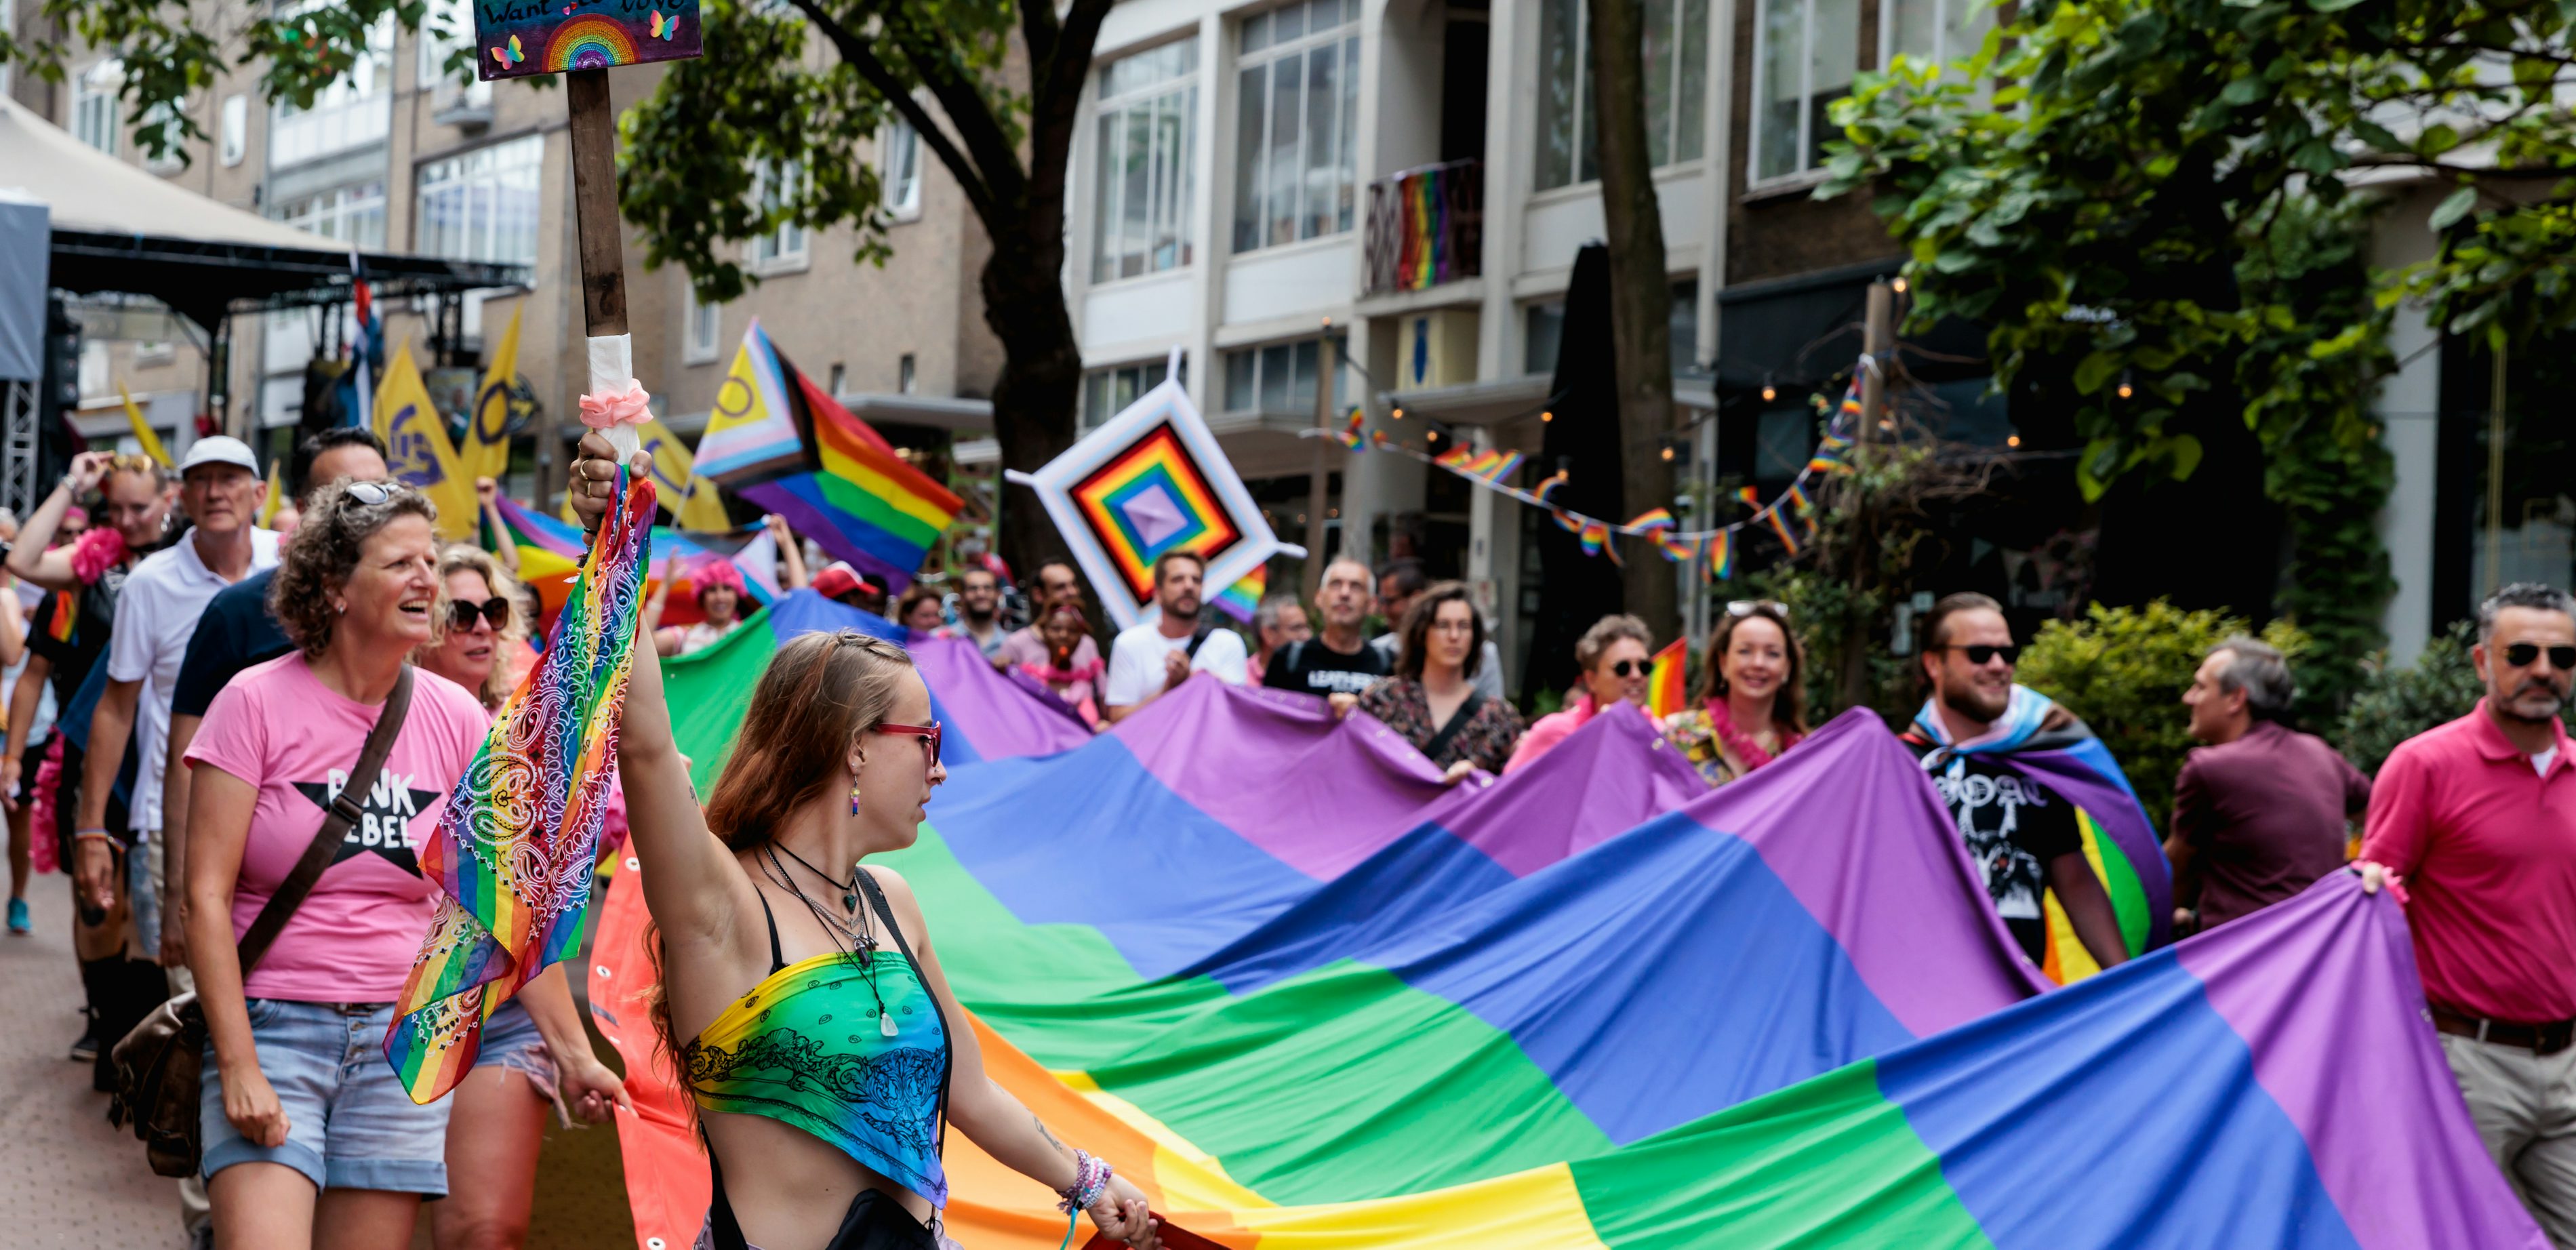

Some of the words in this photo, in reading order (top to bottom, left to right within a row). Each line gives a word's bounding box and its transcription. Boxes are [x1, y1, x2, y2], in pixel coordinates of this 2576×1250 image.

[483, 0, 553, 24] Want
[327, 768, 416, 816] PNK
[344, 812, 420, 849] EBEL
